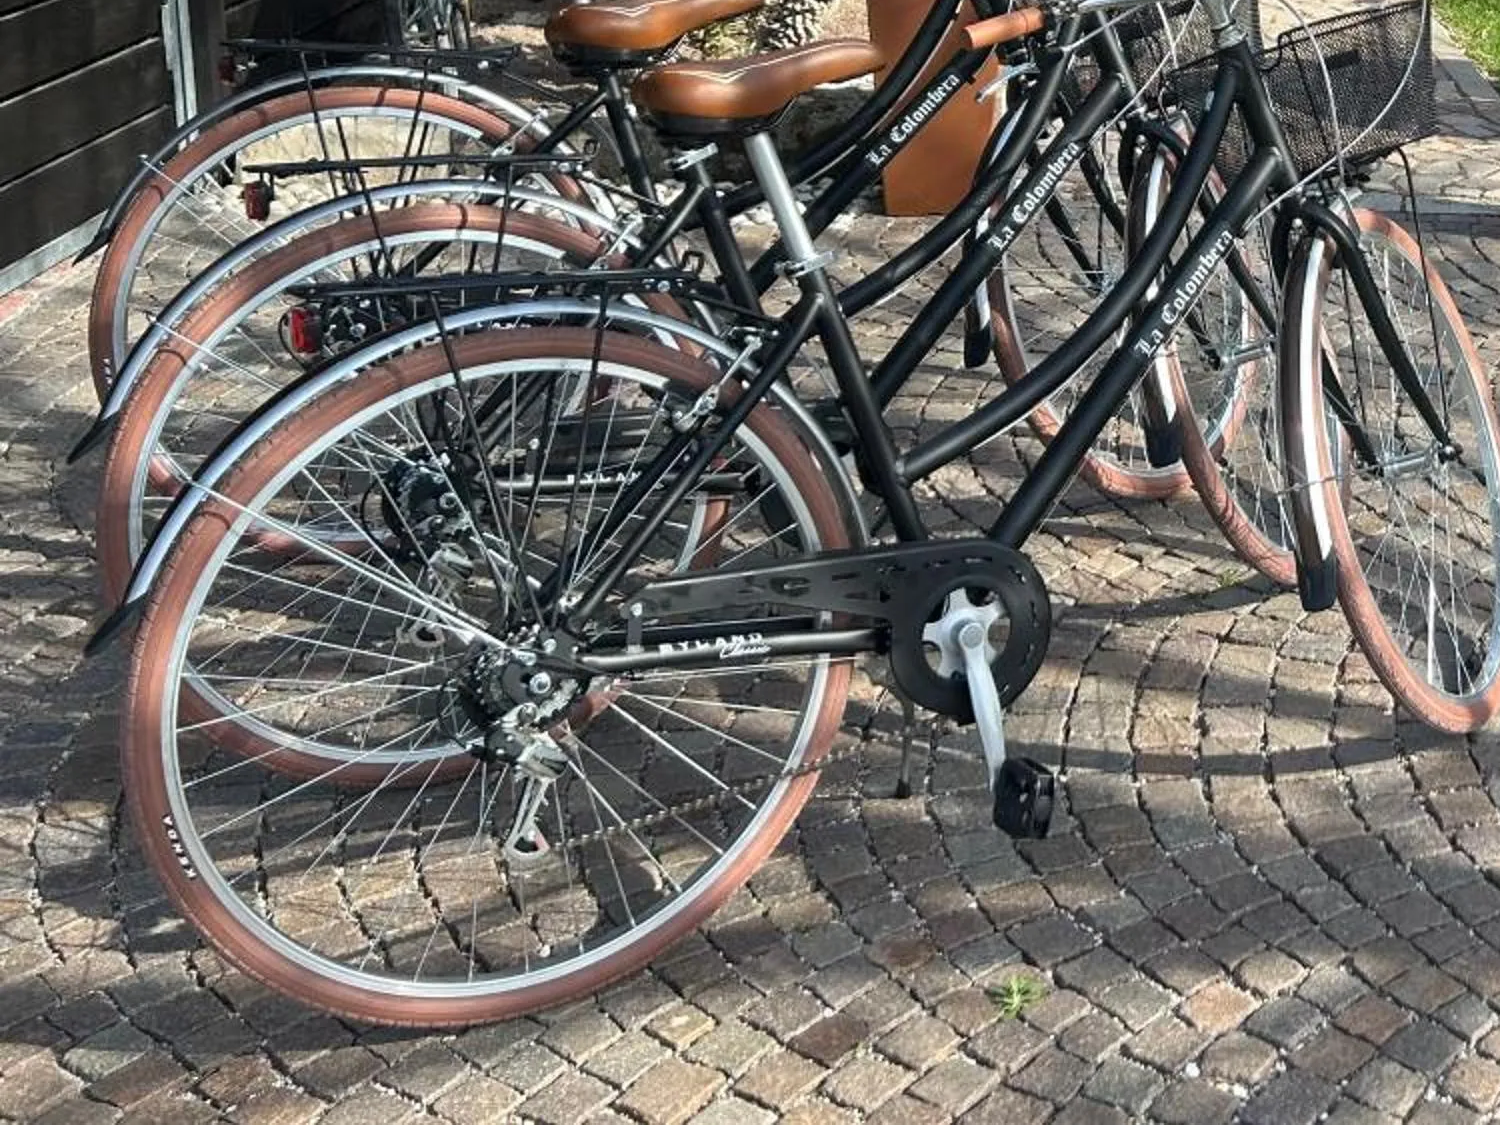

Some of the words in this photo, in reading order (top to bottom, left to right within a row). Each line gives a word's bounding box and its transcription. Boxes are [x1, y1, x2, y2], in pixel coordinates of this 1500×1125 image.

[865, 144, 893, 165] La
[889, 74, 961, 143] Colombera
[987, 225, 1015, 250] La
[1011, 141, 1080, 223] Colombera
[1133, 329, 1164, 357] La
[1161, 230, 1233, 324] Colombera
[163, 816, 198, 878] KENDA
